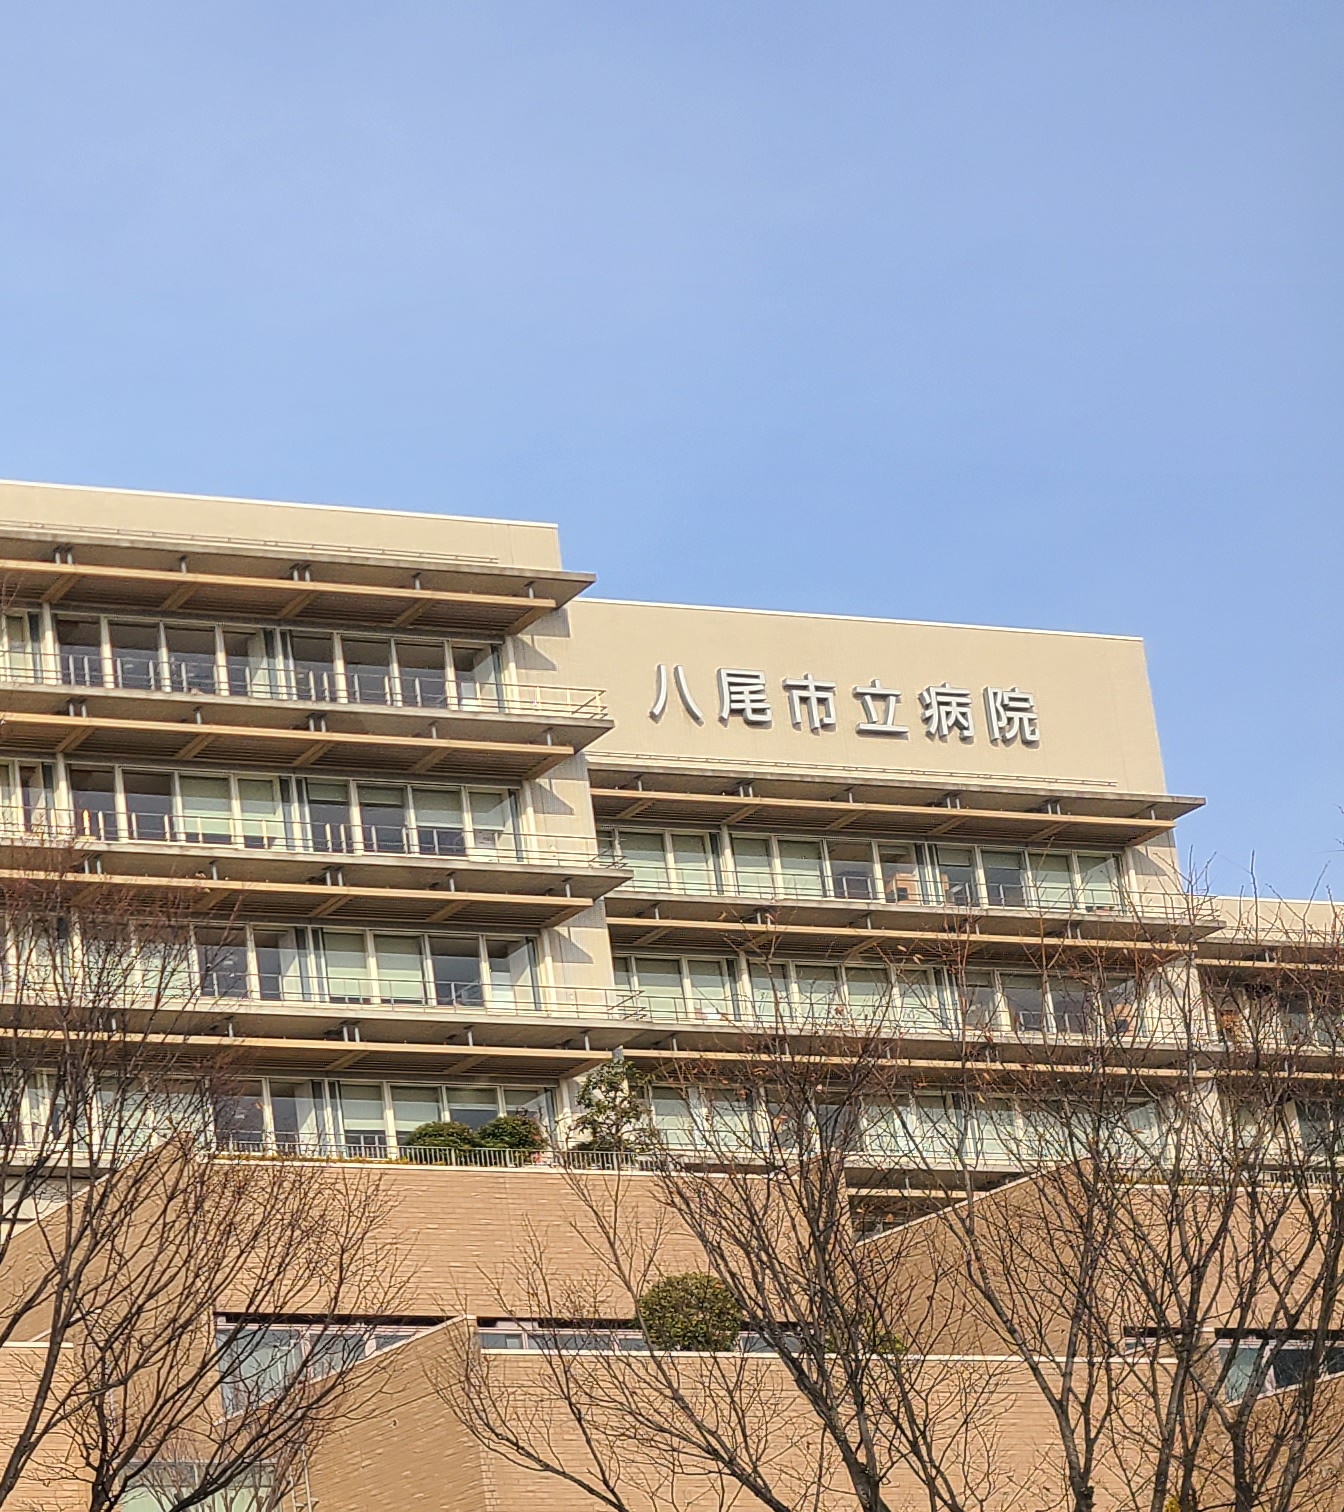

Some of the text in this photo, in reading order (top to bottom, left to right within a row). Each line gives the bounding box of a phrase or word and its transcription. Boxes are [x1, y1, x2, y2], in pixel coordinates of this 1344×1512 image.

[649, 662, 1040, 744] 八尾市立病院
